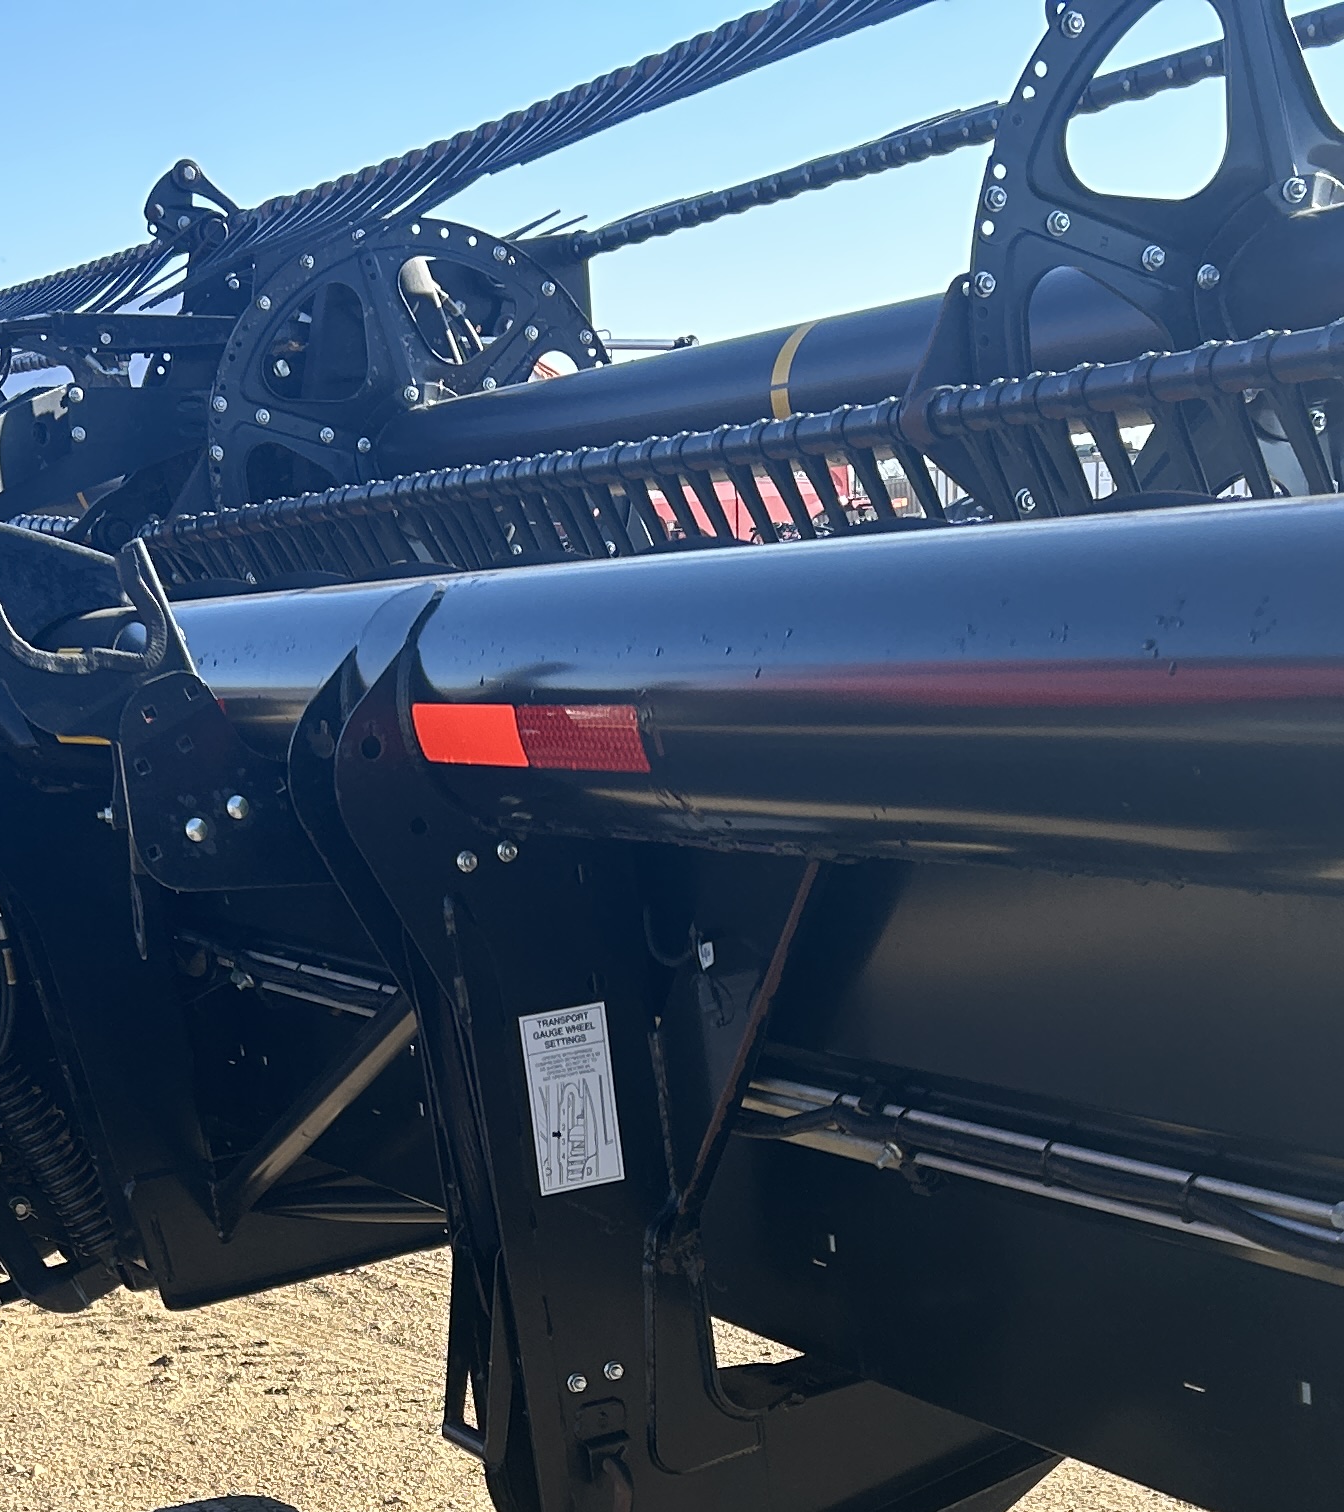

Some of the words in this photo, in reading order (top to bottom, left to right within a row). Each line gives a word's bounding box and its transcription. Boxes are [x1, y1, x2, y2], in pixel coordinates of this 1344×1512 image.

[537, 1011, 588, 1029] TRANSPORT
[533, 1028, 564, 1040] GAUGE
[565, 1021, 596, 1034] WHEEL
[544, 1033, 587, 1049] SETTINGS
